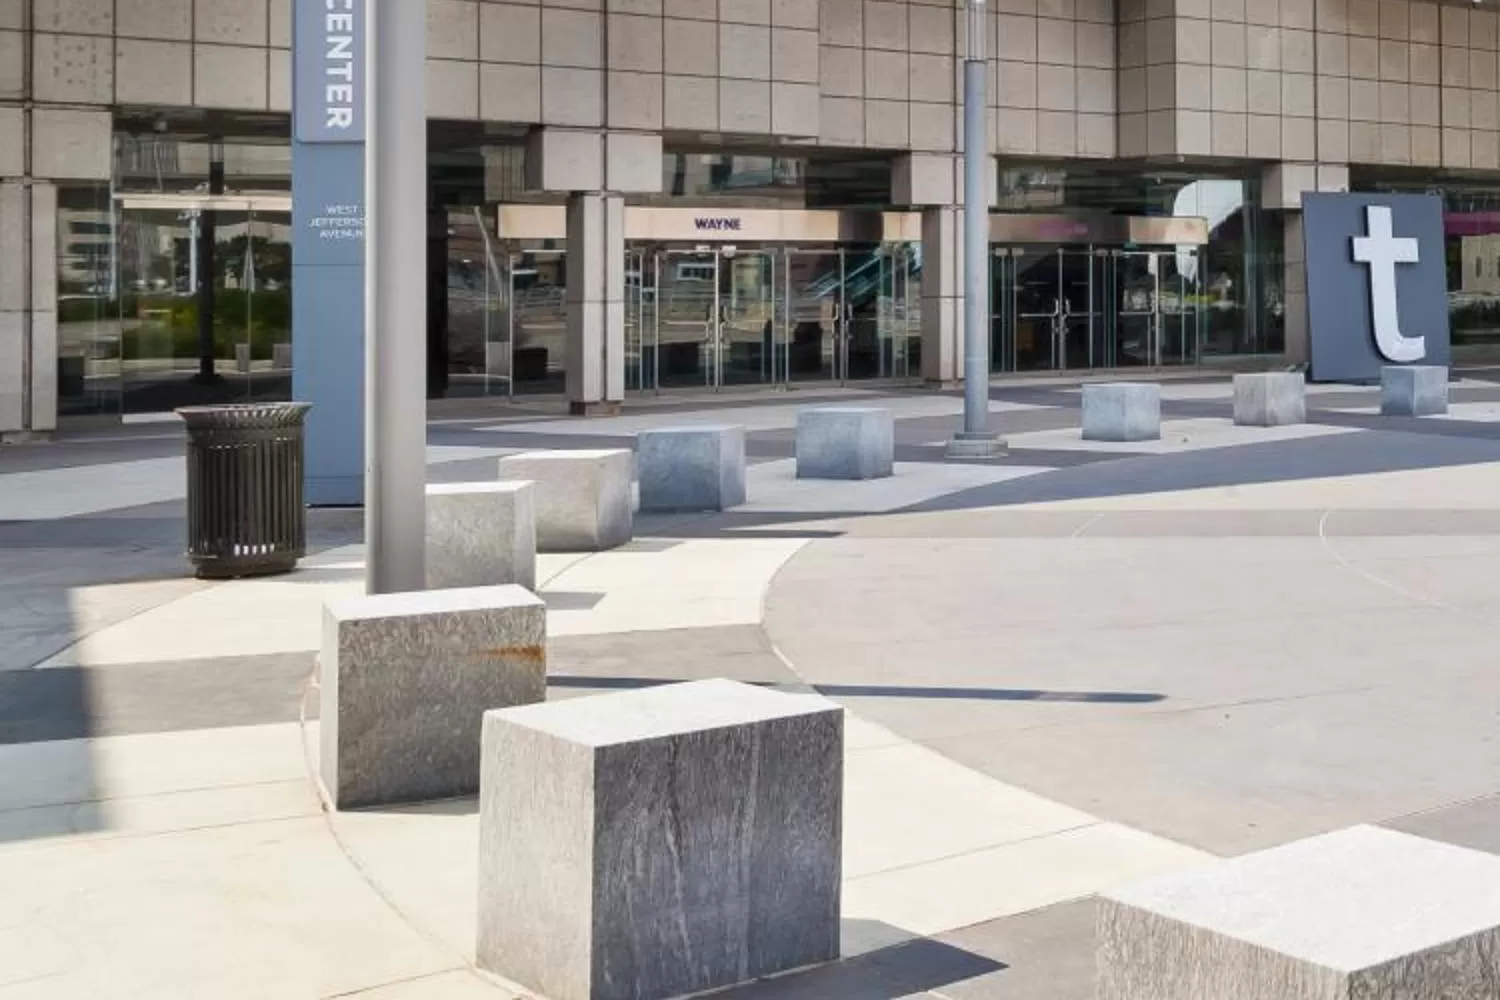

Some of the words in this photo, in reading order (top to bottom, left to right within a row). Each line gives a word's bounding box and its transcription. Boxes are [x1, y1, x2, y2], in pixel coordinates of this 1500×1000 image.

[309, 218, 366, 227] JEFFERSO
[694, 217, 741, 230] WAYNE
[1352, 205, 1426, 362] t
